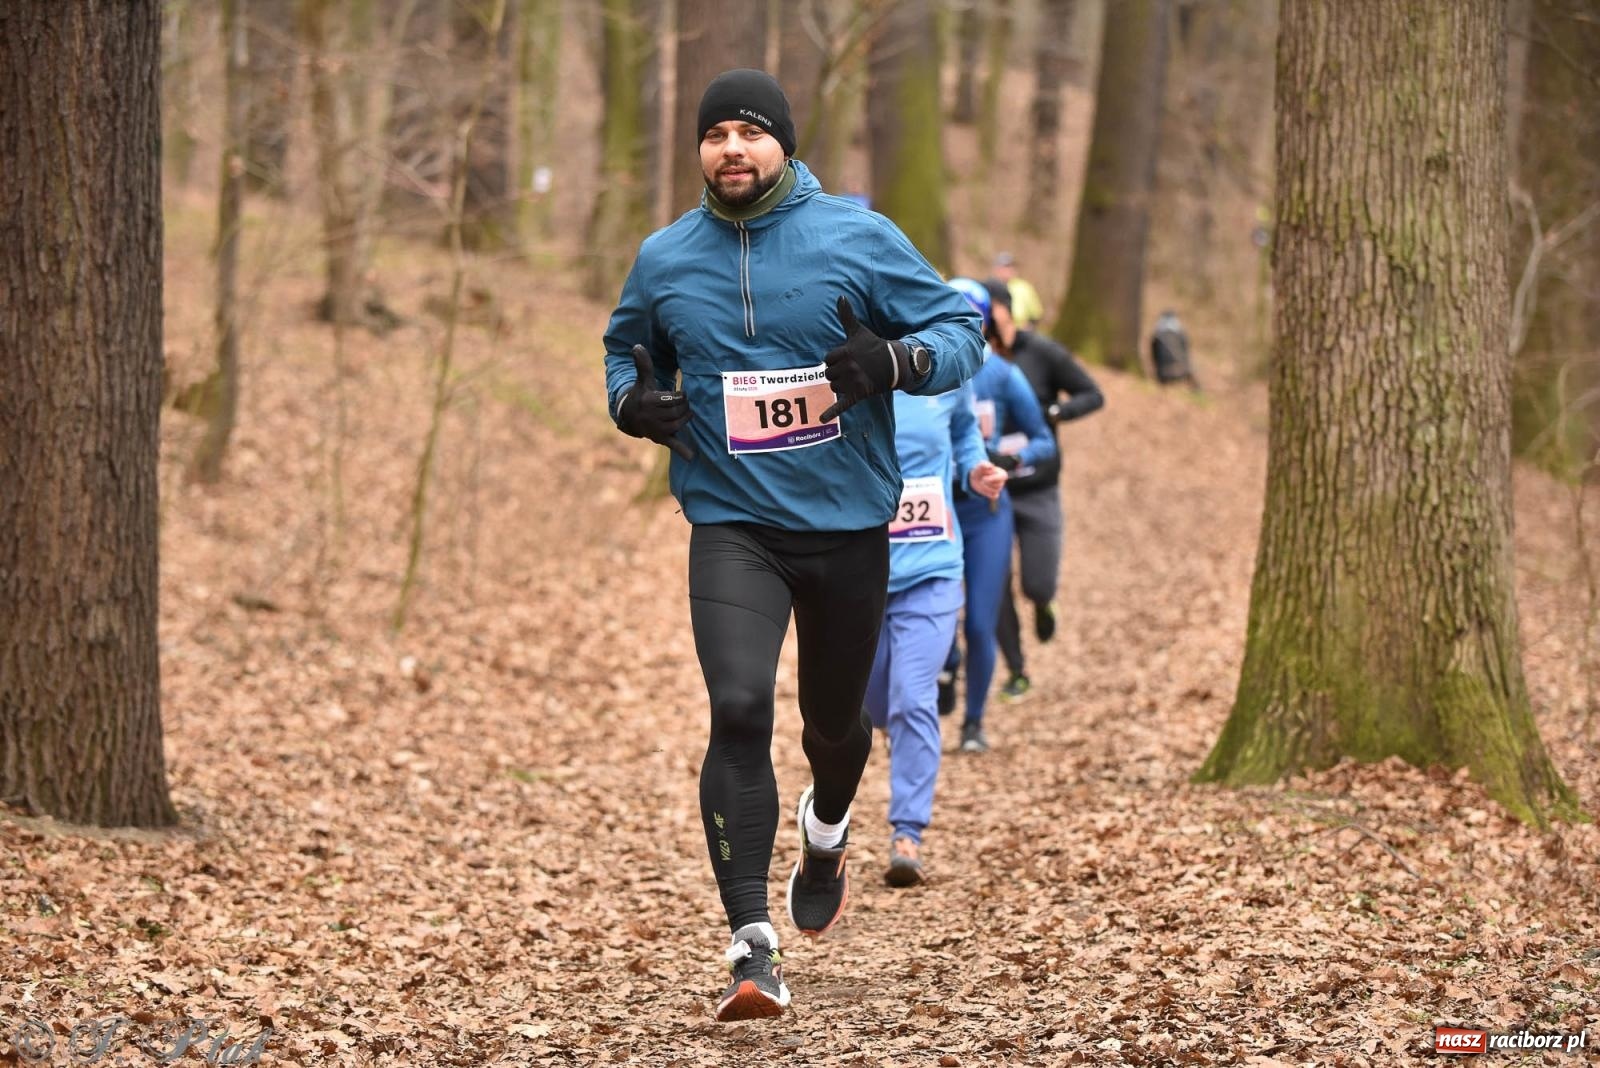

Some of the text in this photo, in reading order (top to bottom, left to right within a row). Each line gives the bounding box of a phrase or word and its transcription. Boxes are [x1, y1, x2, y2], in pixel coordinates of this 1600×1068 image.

[732, 376, 757, 385] BIEG
[755, 397, 808, 429] 181
[889, 500, 930, 522] 32
